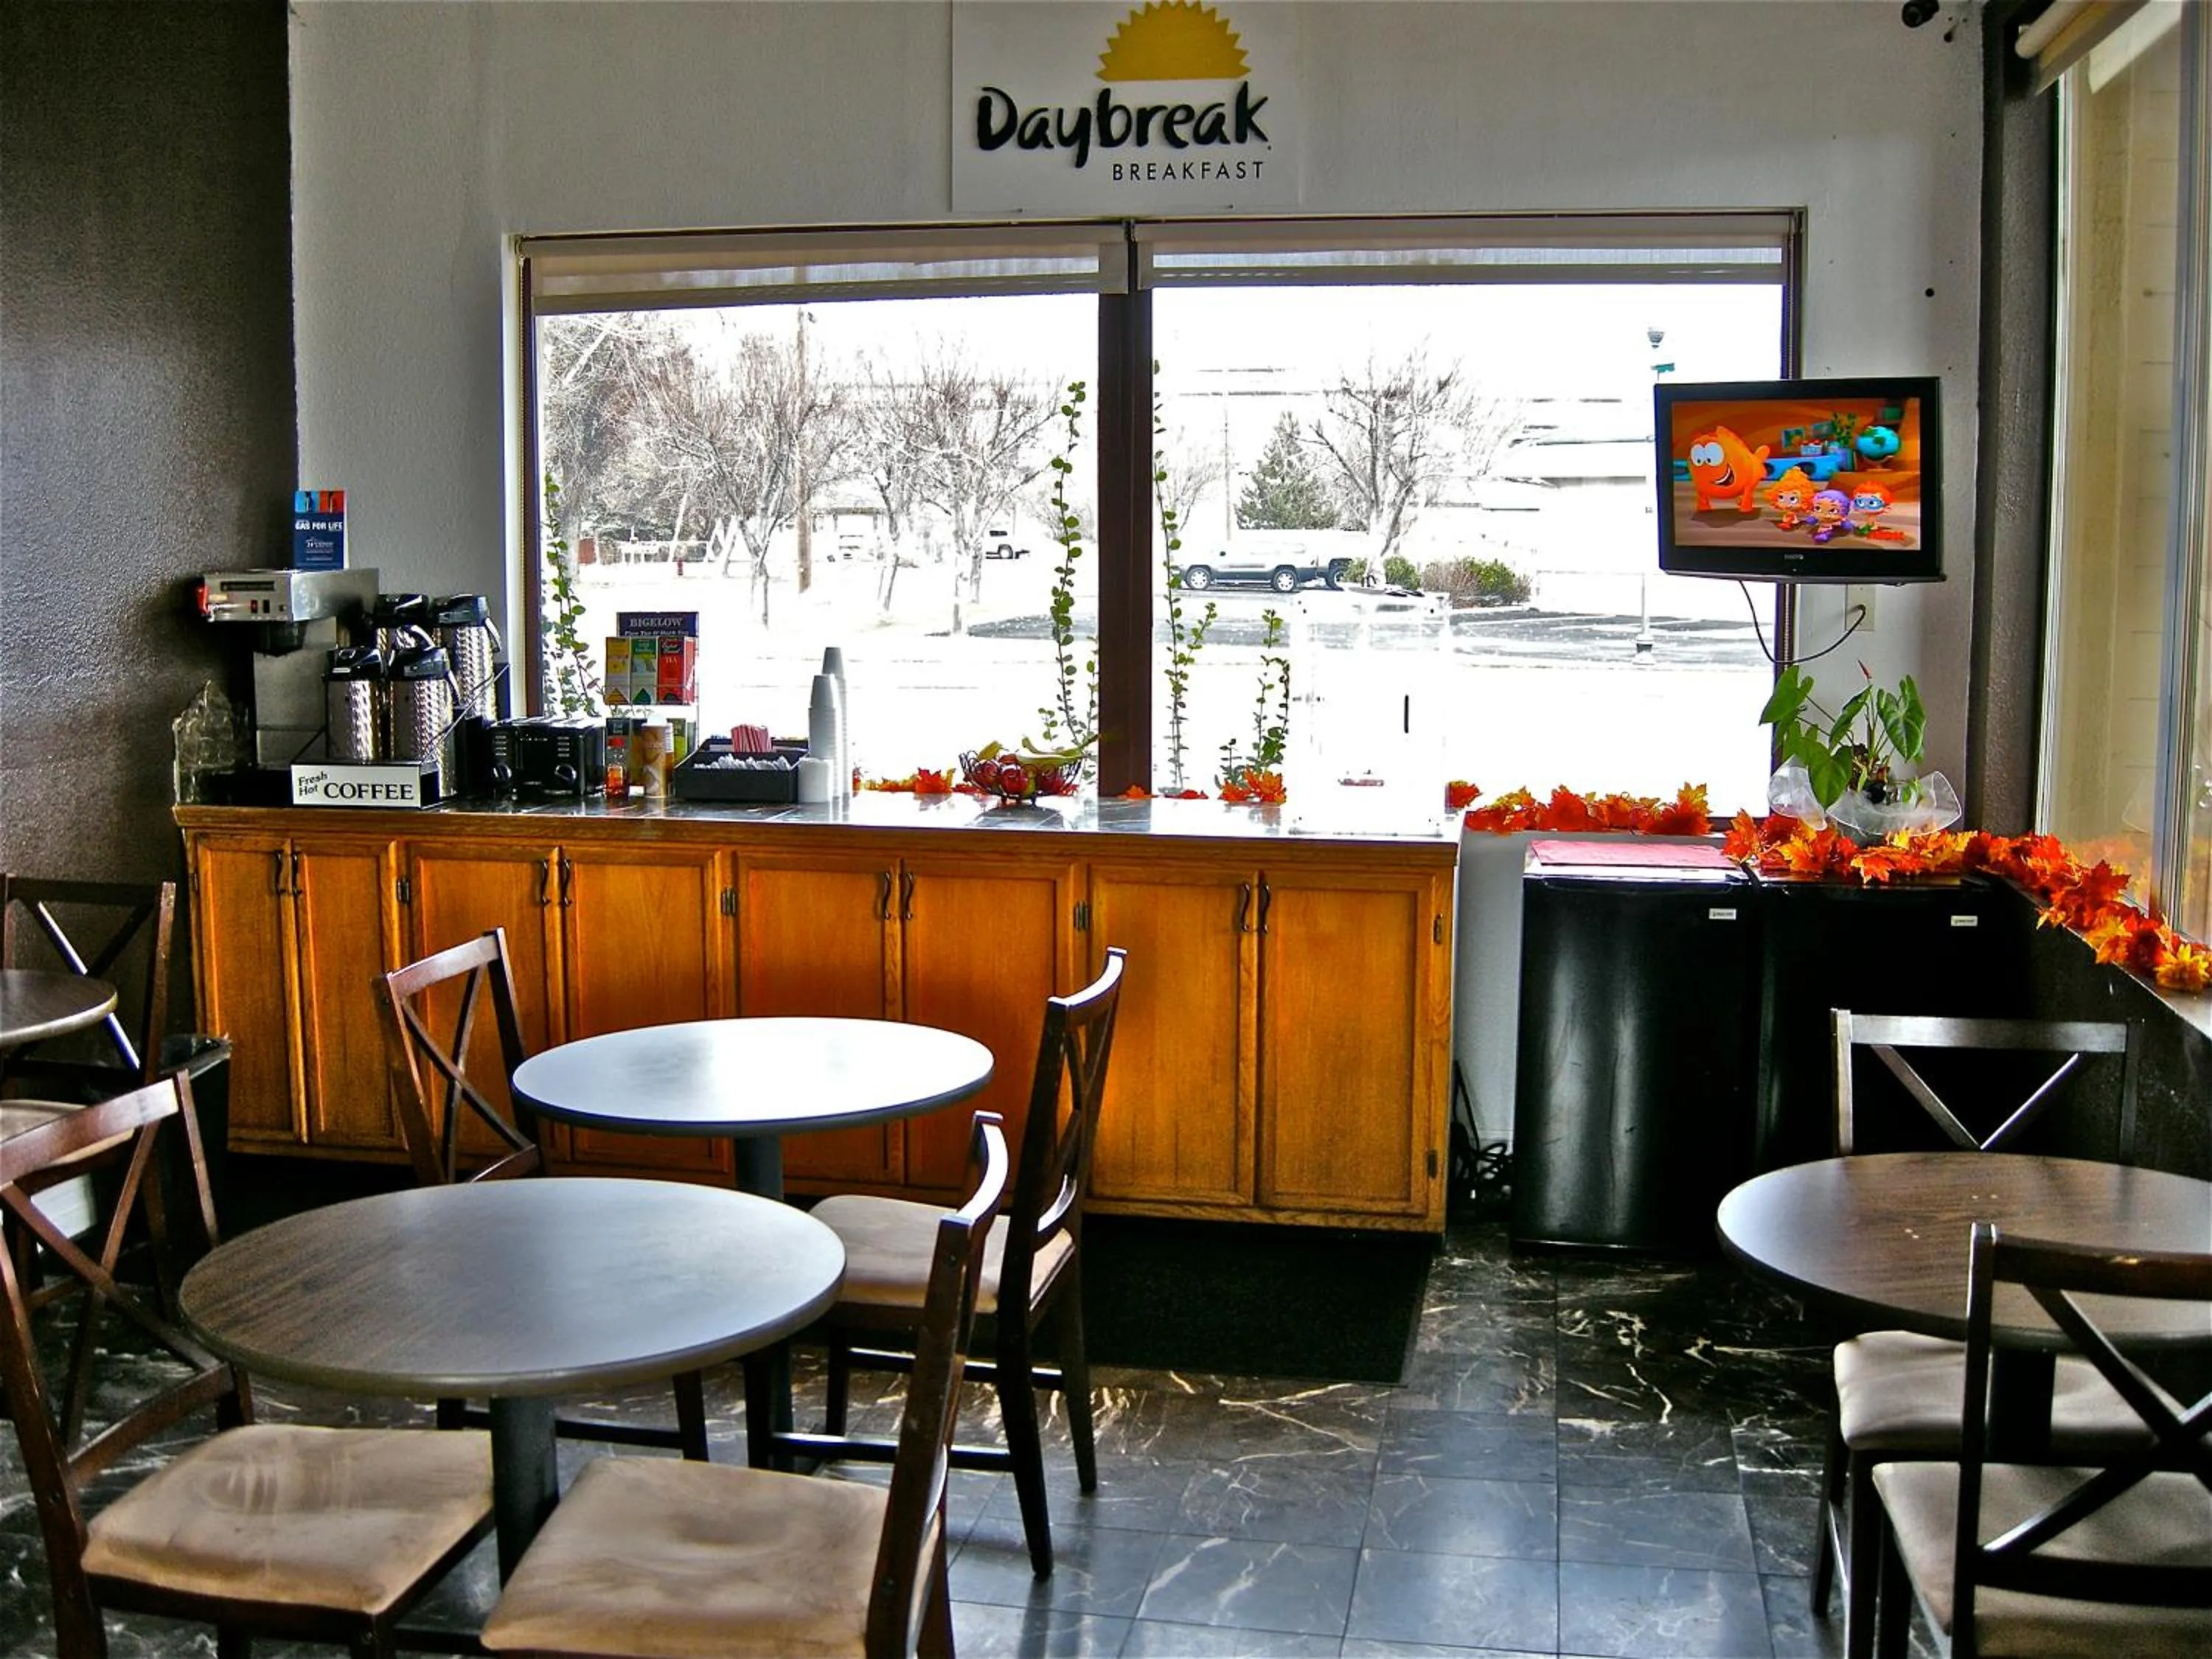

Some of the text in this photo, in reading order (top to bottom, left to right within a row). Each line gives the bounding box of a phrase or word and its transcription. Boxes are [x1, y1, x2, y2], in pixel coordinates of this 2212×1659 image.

[977, 81, 1268, 168] Daybreak
[1112, 161, 1264, 181] BREAKFAST
[295, 519, 343, 531] GAS FOR LIFE
[629, 617, 684, 627] BIGELOW
[298, 771, 328, 787] Fresh
[298, 782, 414, 801] Hot COFFEE
